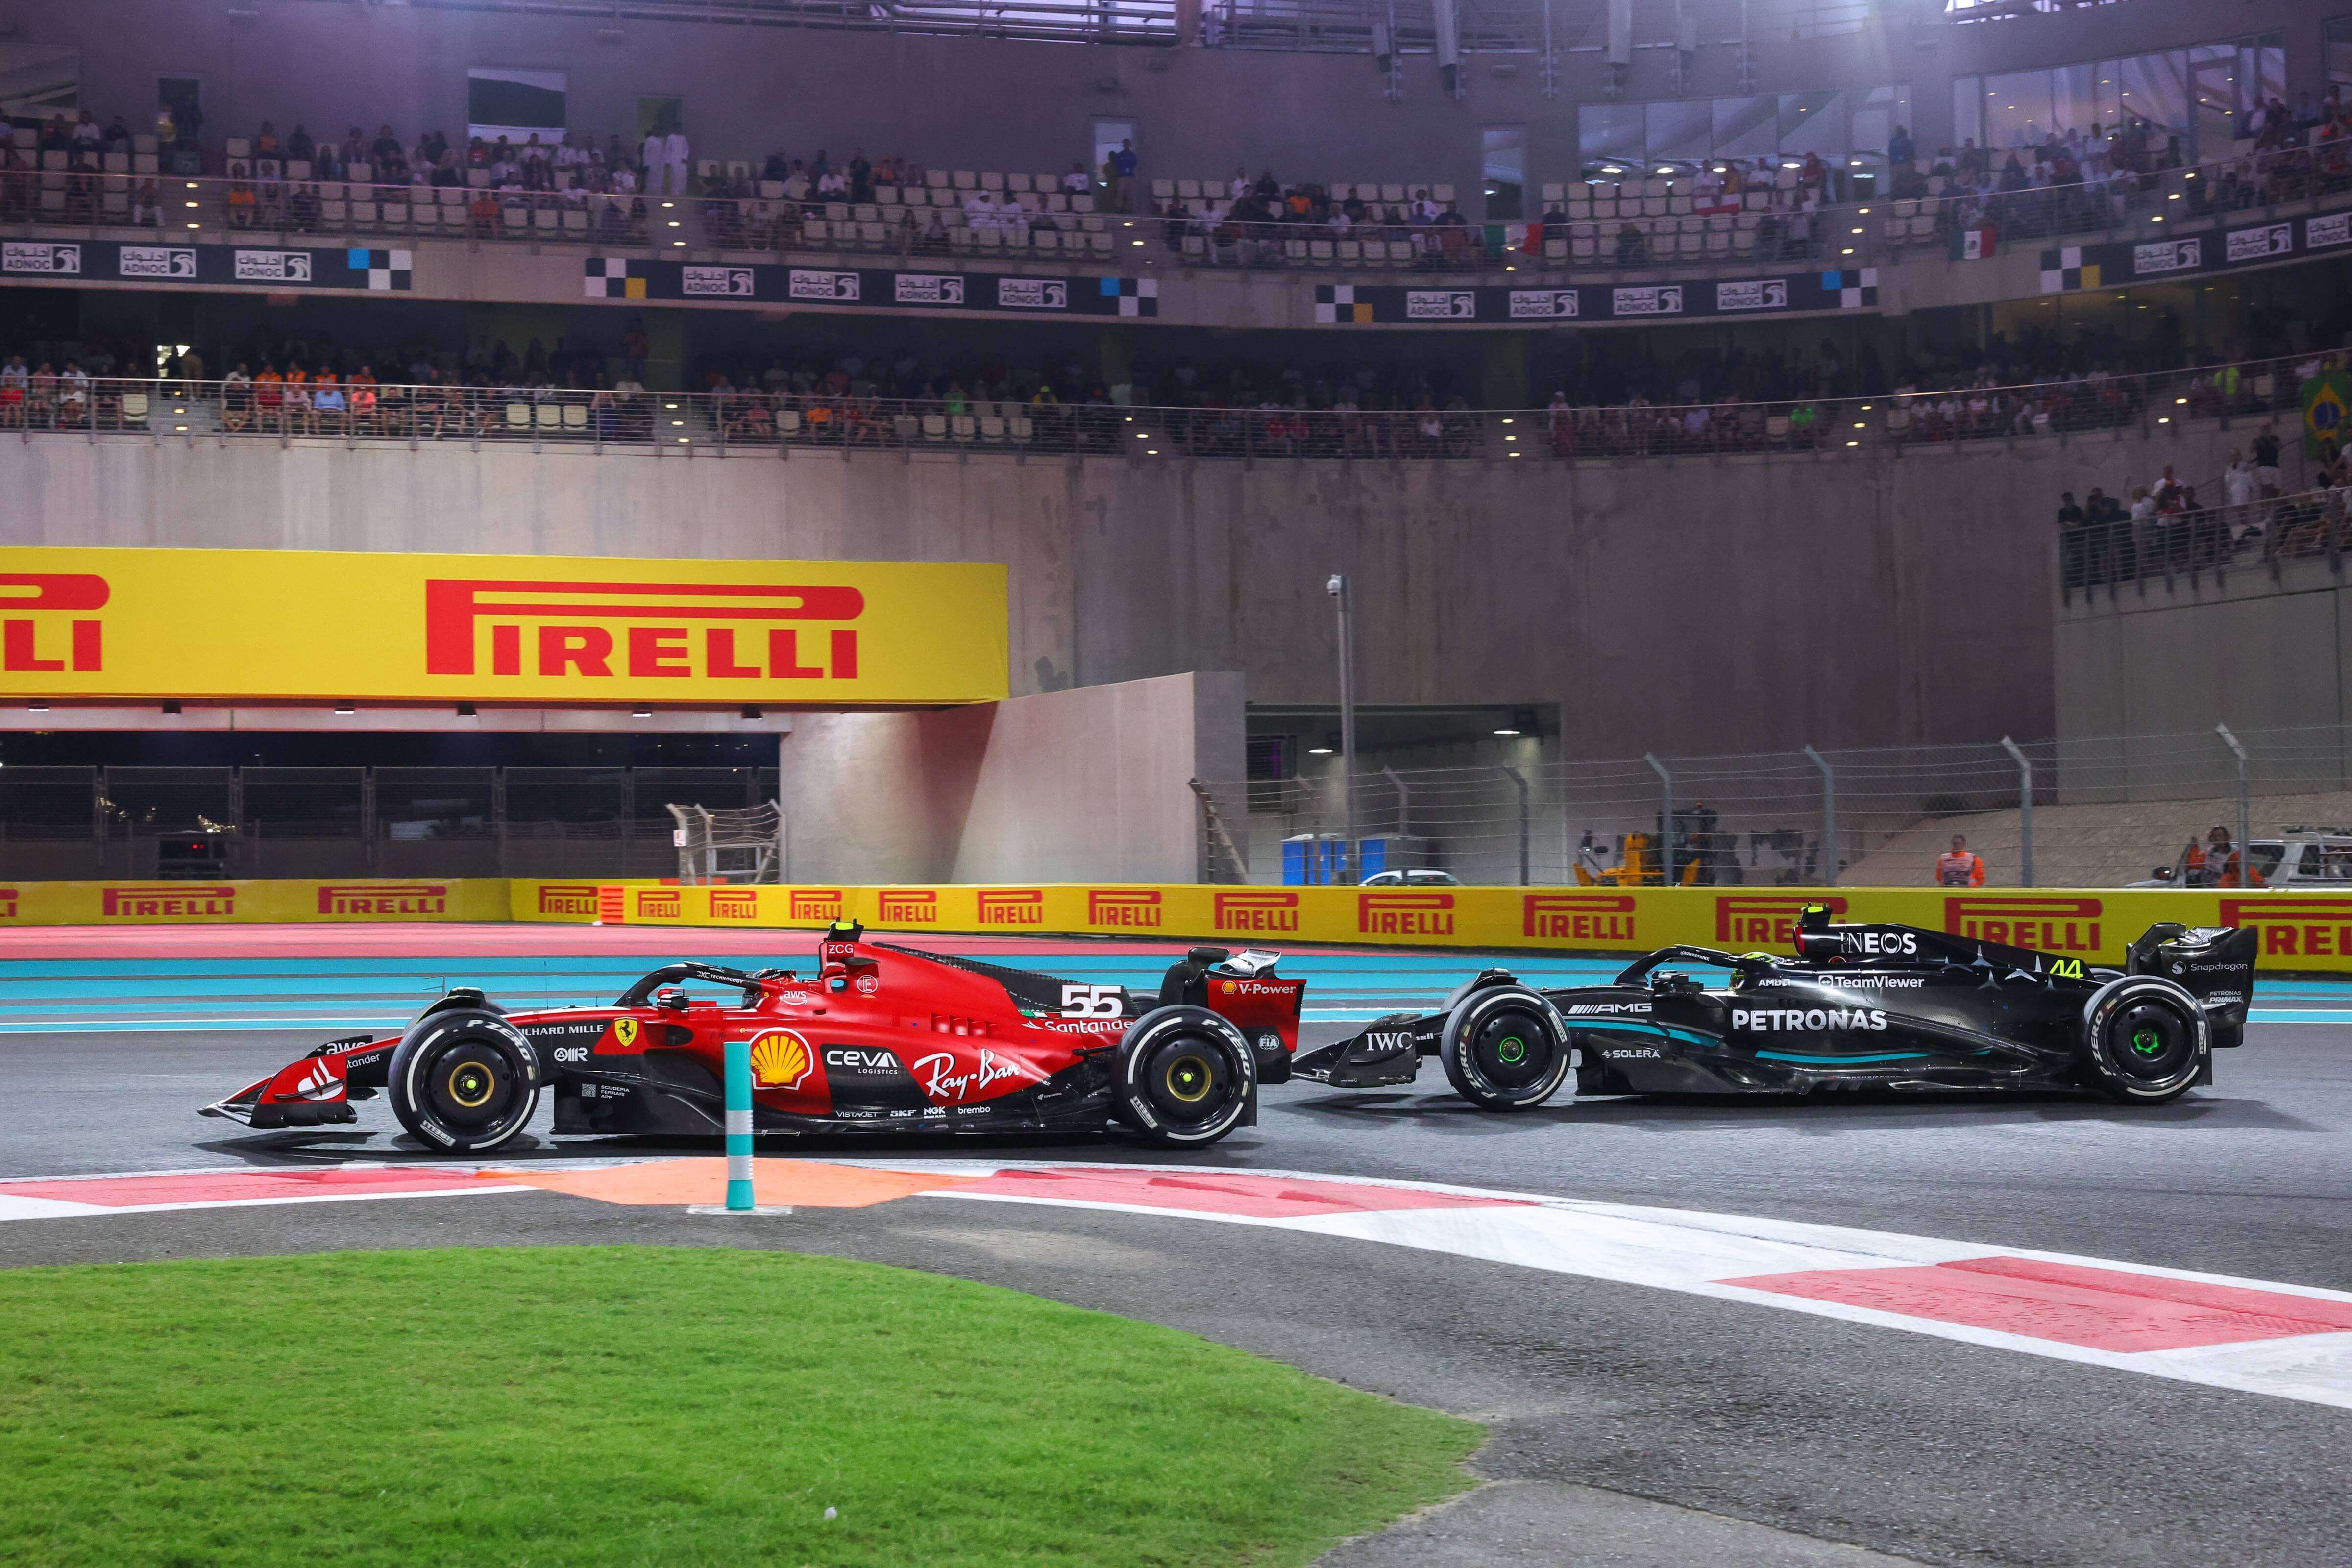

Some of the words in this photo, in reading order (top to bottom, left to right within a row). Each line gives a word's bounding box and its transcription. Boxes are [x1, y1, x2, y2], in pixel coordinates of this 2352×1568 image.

[2309, 231, 2347, 244] ADNOC
[2230, 244, 2267, 257] ADNOC
[7, 260, 50, 269] ADNOC
[125, 264, 167, 273] ADNOC
[2137, 257, 2176, 270] ADNOC
[239, 267, 282, 277] ADNOC
[687, 283, 727, 292] ADNOC
[793, 286, 833, 296] ADNOC
[899, 291, 937, 300] ADNOC
[1002, 294, 1042, 304] ADNOC
[1720, 296, 1760, 307] ADNOC
[1514, 306, 1553, 315] ADNOC
[1617, 302, 1656, 312] ADNOC
[426, 579, 864, 679] PIRELLI
[103, 887, 235, 916] PIRELLI
[318, 886, 447, 914] PIRELLI
[539, 886, 597, 914] PIRELLI
[638, 891, 680, 918] PIRELLI
[710, 890, 757, 919] PIRELLI
[790, 890, 842, 920] PIRELLI
[879, 890, 937, 923] PIRELLI
[978, 890, 1043, 924] PIRELLI
[1089, 890, 1162, 926] PIRELLI
[1214, 893, 1299, 931] PIRELLI
[1358, 894, 1455, 935] PIRELLI
[1523, 895, 1636, 940] PIRELLI
[1945, 897, 2103, 951] PIRELLI
[1839, 932, 1917, 954] INEOS
[1681, 951, 1710, 961] CROWDSTRIKE
[2049, 960, 2083, 978] 44
[2191, 962, 2248, 972] Snapdragon
[710, 974, 744, 984] TECHNOLOGY
[1835, 976, 1925, 988] TeamViewer
[784, 990, 807, 999] aws
[1239, 983, 1296, 994] V-Power
[1061, 985, 1123, 1018] 55
[1594, 1003, 1652, 1013] AMG
[1045, 1019, 1133, 1034] Santande
[1732, 1009, 1887, 1031] PETRONAS
[518, 1026, 564, 1036] ICHARD
[569, 1025, 604, 1034] MILLE
[2091, 1011, 2104, 1062] ZERO
[484, 1022, 532, 1061] ZERO
[1260, 1038, 1277, 1047] FIA
[1366, 1032, 1413, 1051] IWC
[1218, 1027, 1251, 1077] ZERO
[1612, 1050, 1661, 1058] SOLERA
[1460, 1042, 1482, 1089] ZERO
[923, 1106, 946, 1115] NGK
[958, 1106, 991, 1114] brembo
